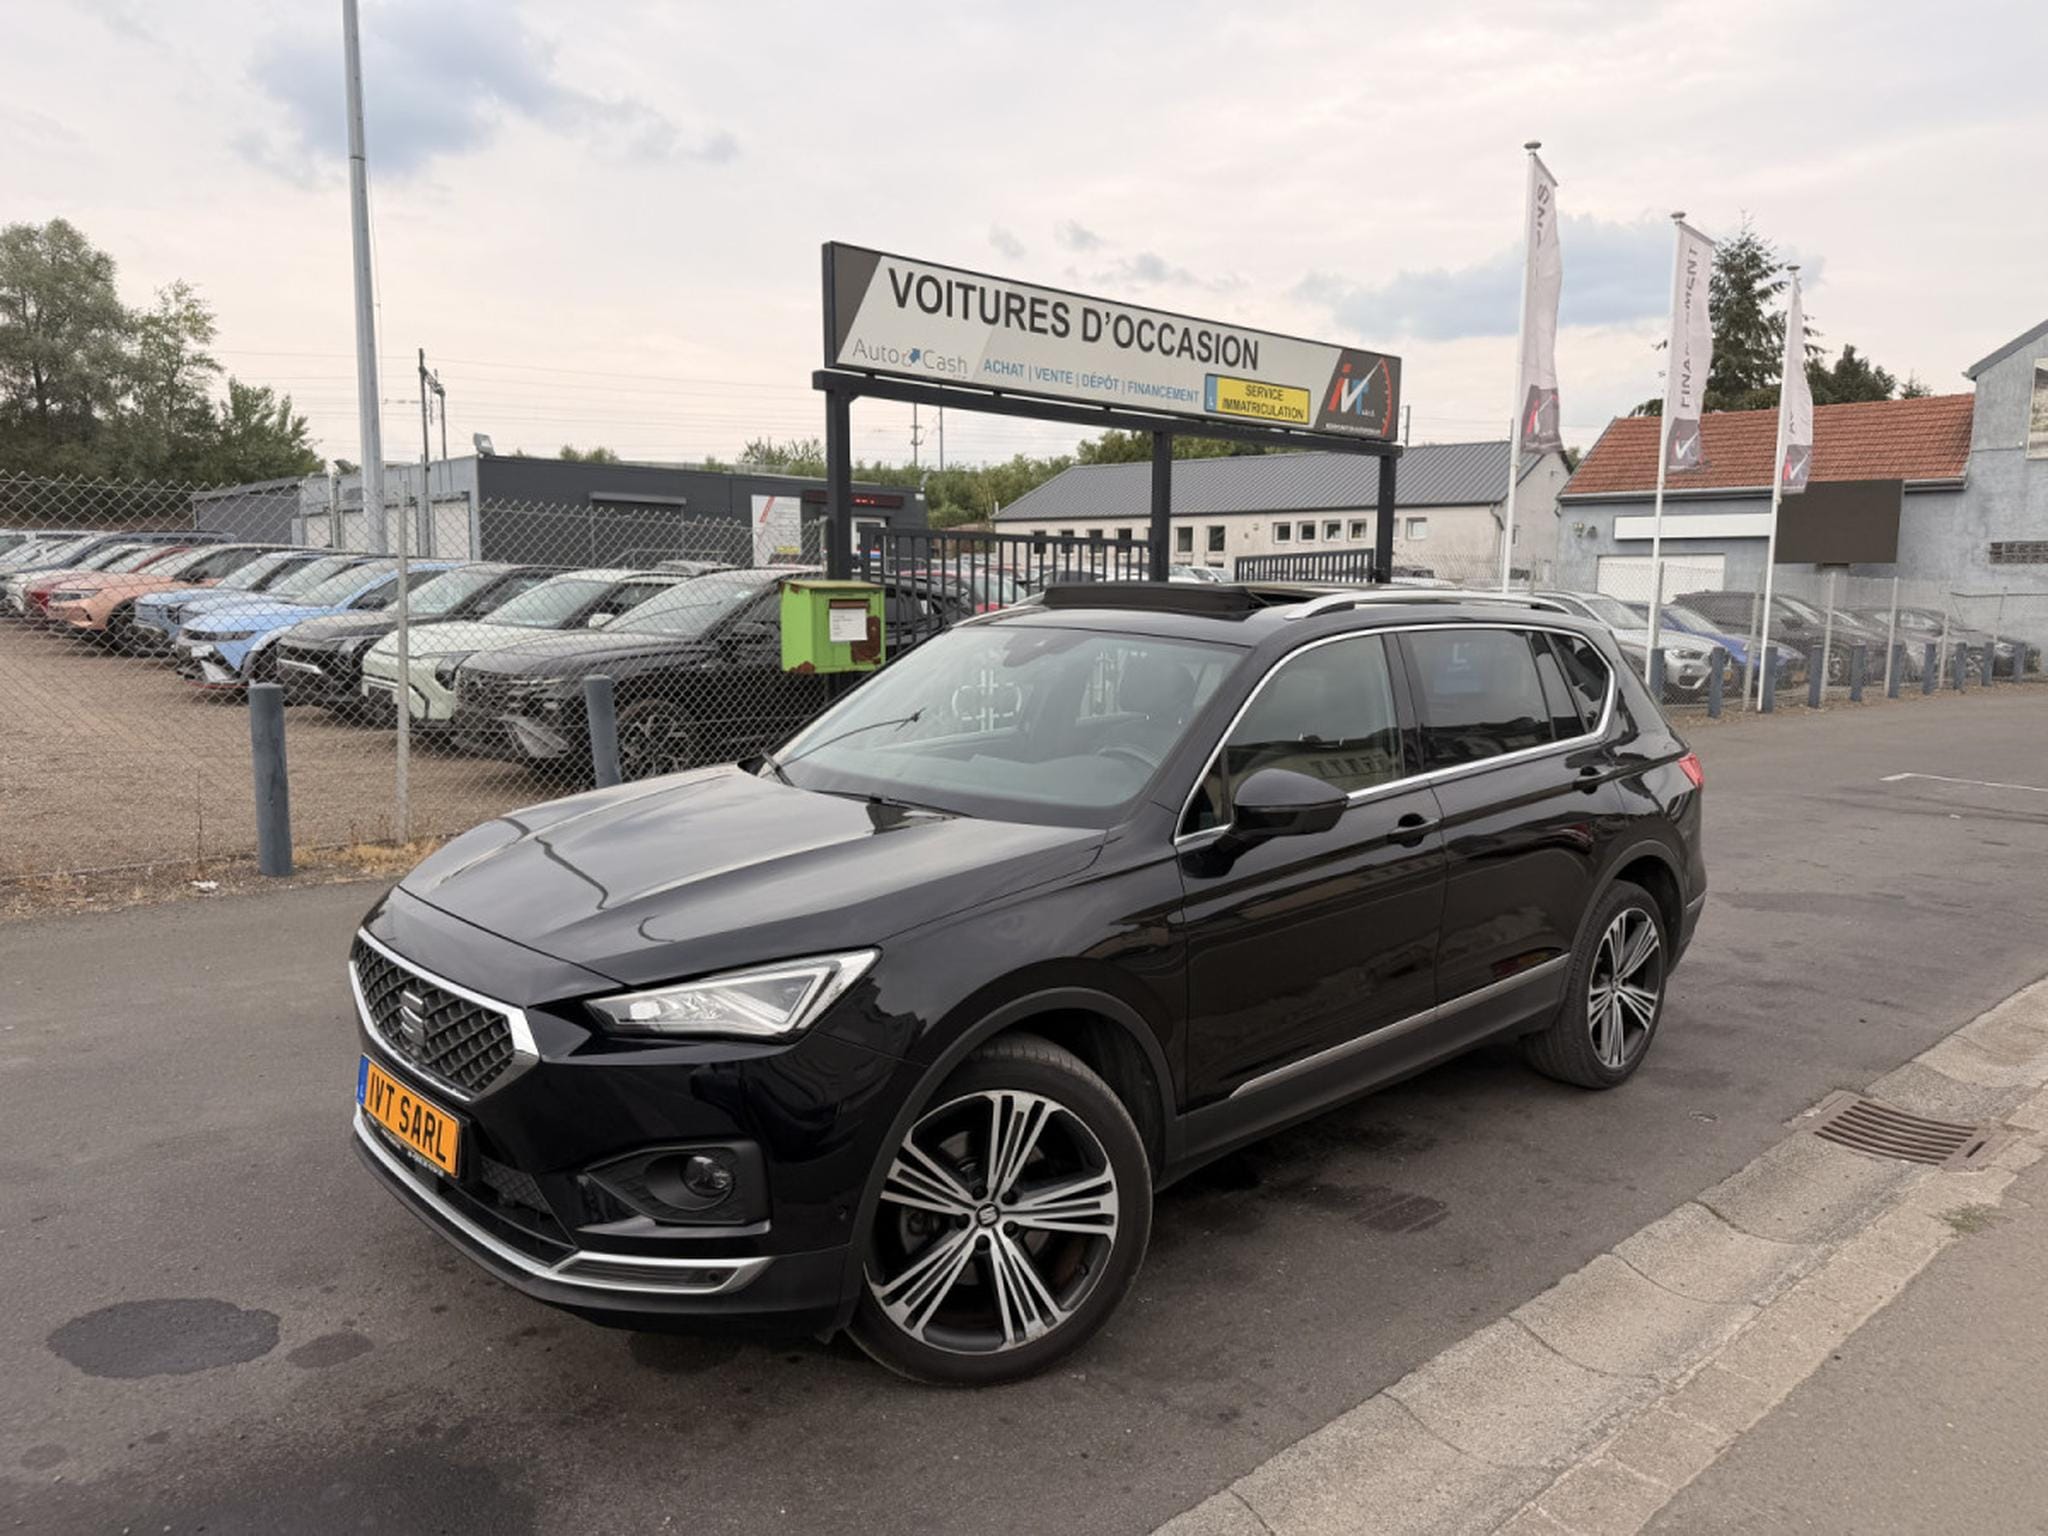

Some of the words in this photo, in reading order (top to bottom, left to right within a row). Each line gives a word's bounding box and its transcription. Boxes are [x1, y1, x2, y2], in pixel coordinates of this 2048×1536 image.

[888, 267, 1071, 338] VOITURES
[1082, 307, 1259, 371] D'OCCASION
[1681, 247, 1699, 408] FINAMENT
[852, 338, 900, 365] Auto
[922, 349, 968, 374] Cash
[983, 358, 1025, 378] ACHAT
[1035, 366, 1073, 385] VENTE
[1081, 372, 1120, 392] DÉPÔT
[1127, 380, 1200, 404] FINANCEMENT
[1244, 384, 1284, 401] SERVICE
[1222, 397, 1305, 420] IMMATRICULATION
[369, 1071, 395, 1121] IVT
[398, 1095, 447, 1164] SARL
